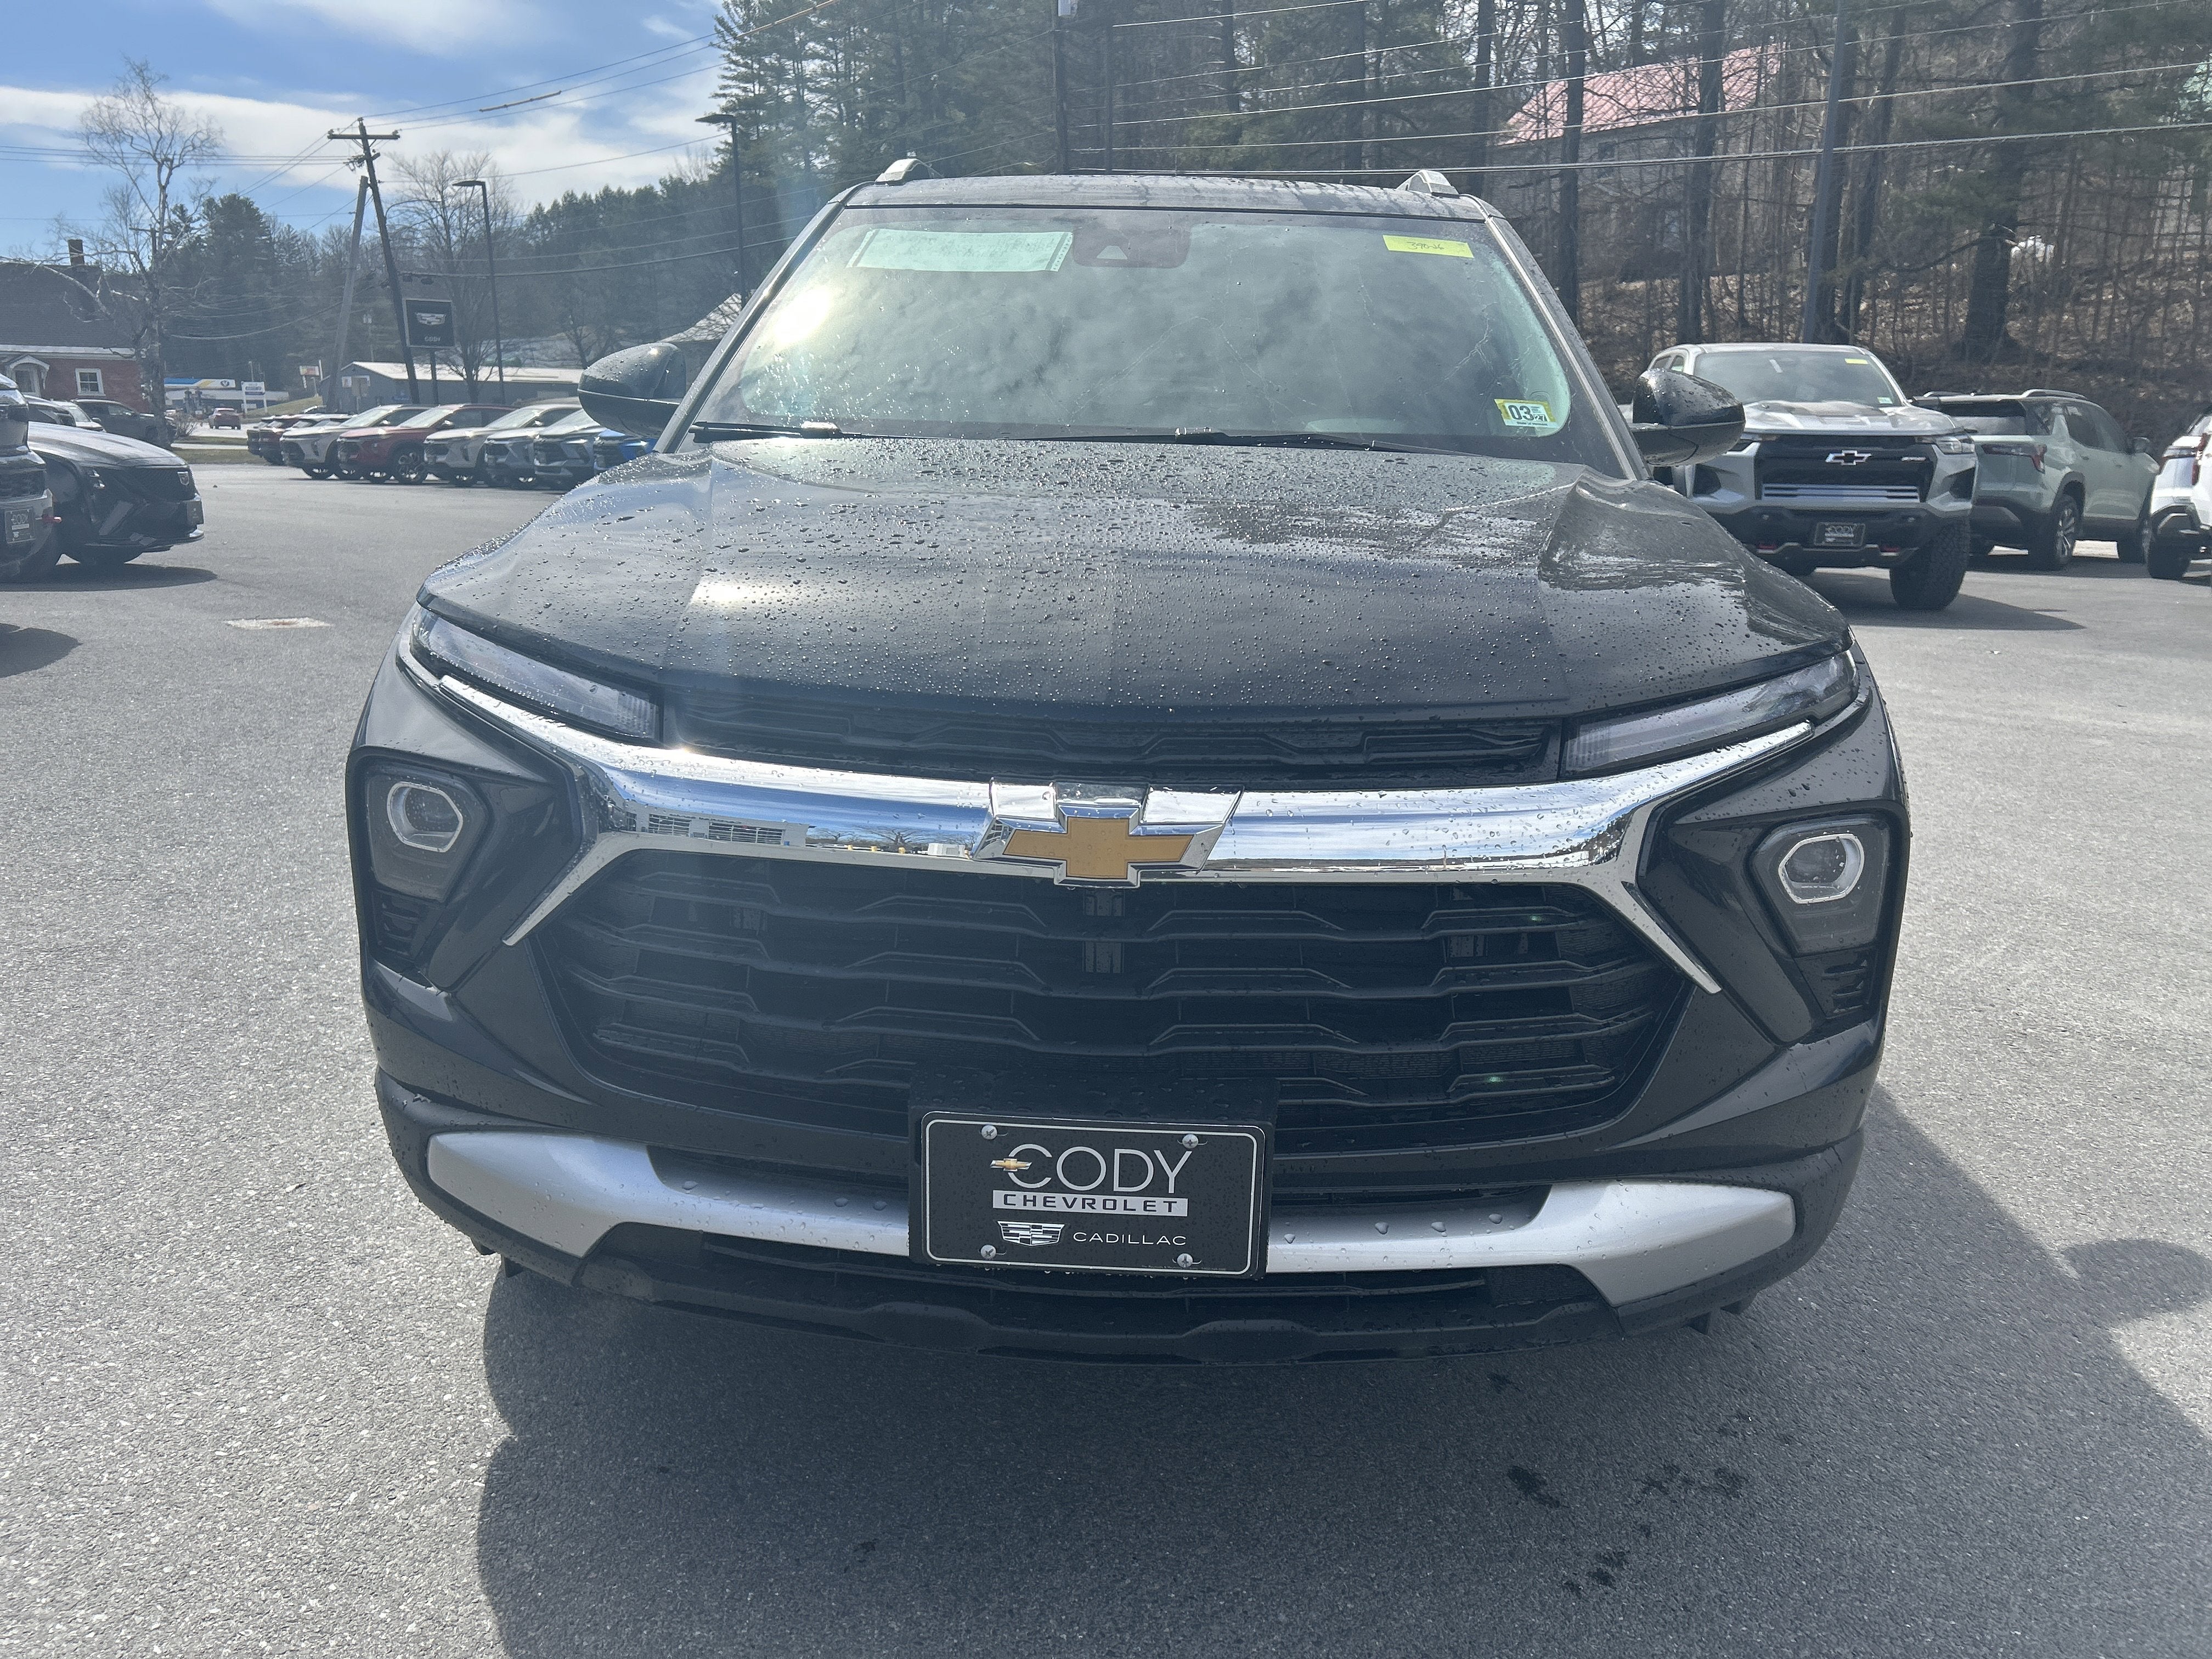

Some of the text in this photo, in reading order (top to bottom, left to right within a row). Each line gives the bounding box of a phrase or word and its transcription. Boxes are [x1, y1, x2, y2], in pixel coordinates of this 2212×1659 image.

[1508, 405, 1534, 421] 03
[1007, 1143, 1193, 1194] CODY
[1003, 1194, 1178, 1213] CHEVROLET
[1073, 1232, 1187, 1246] CADILLAC
